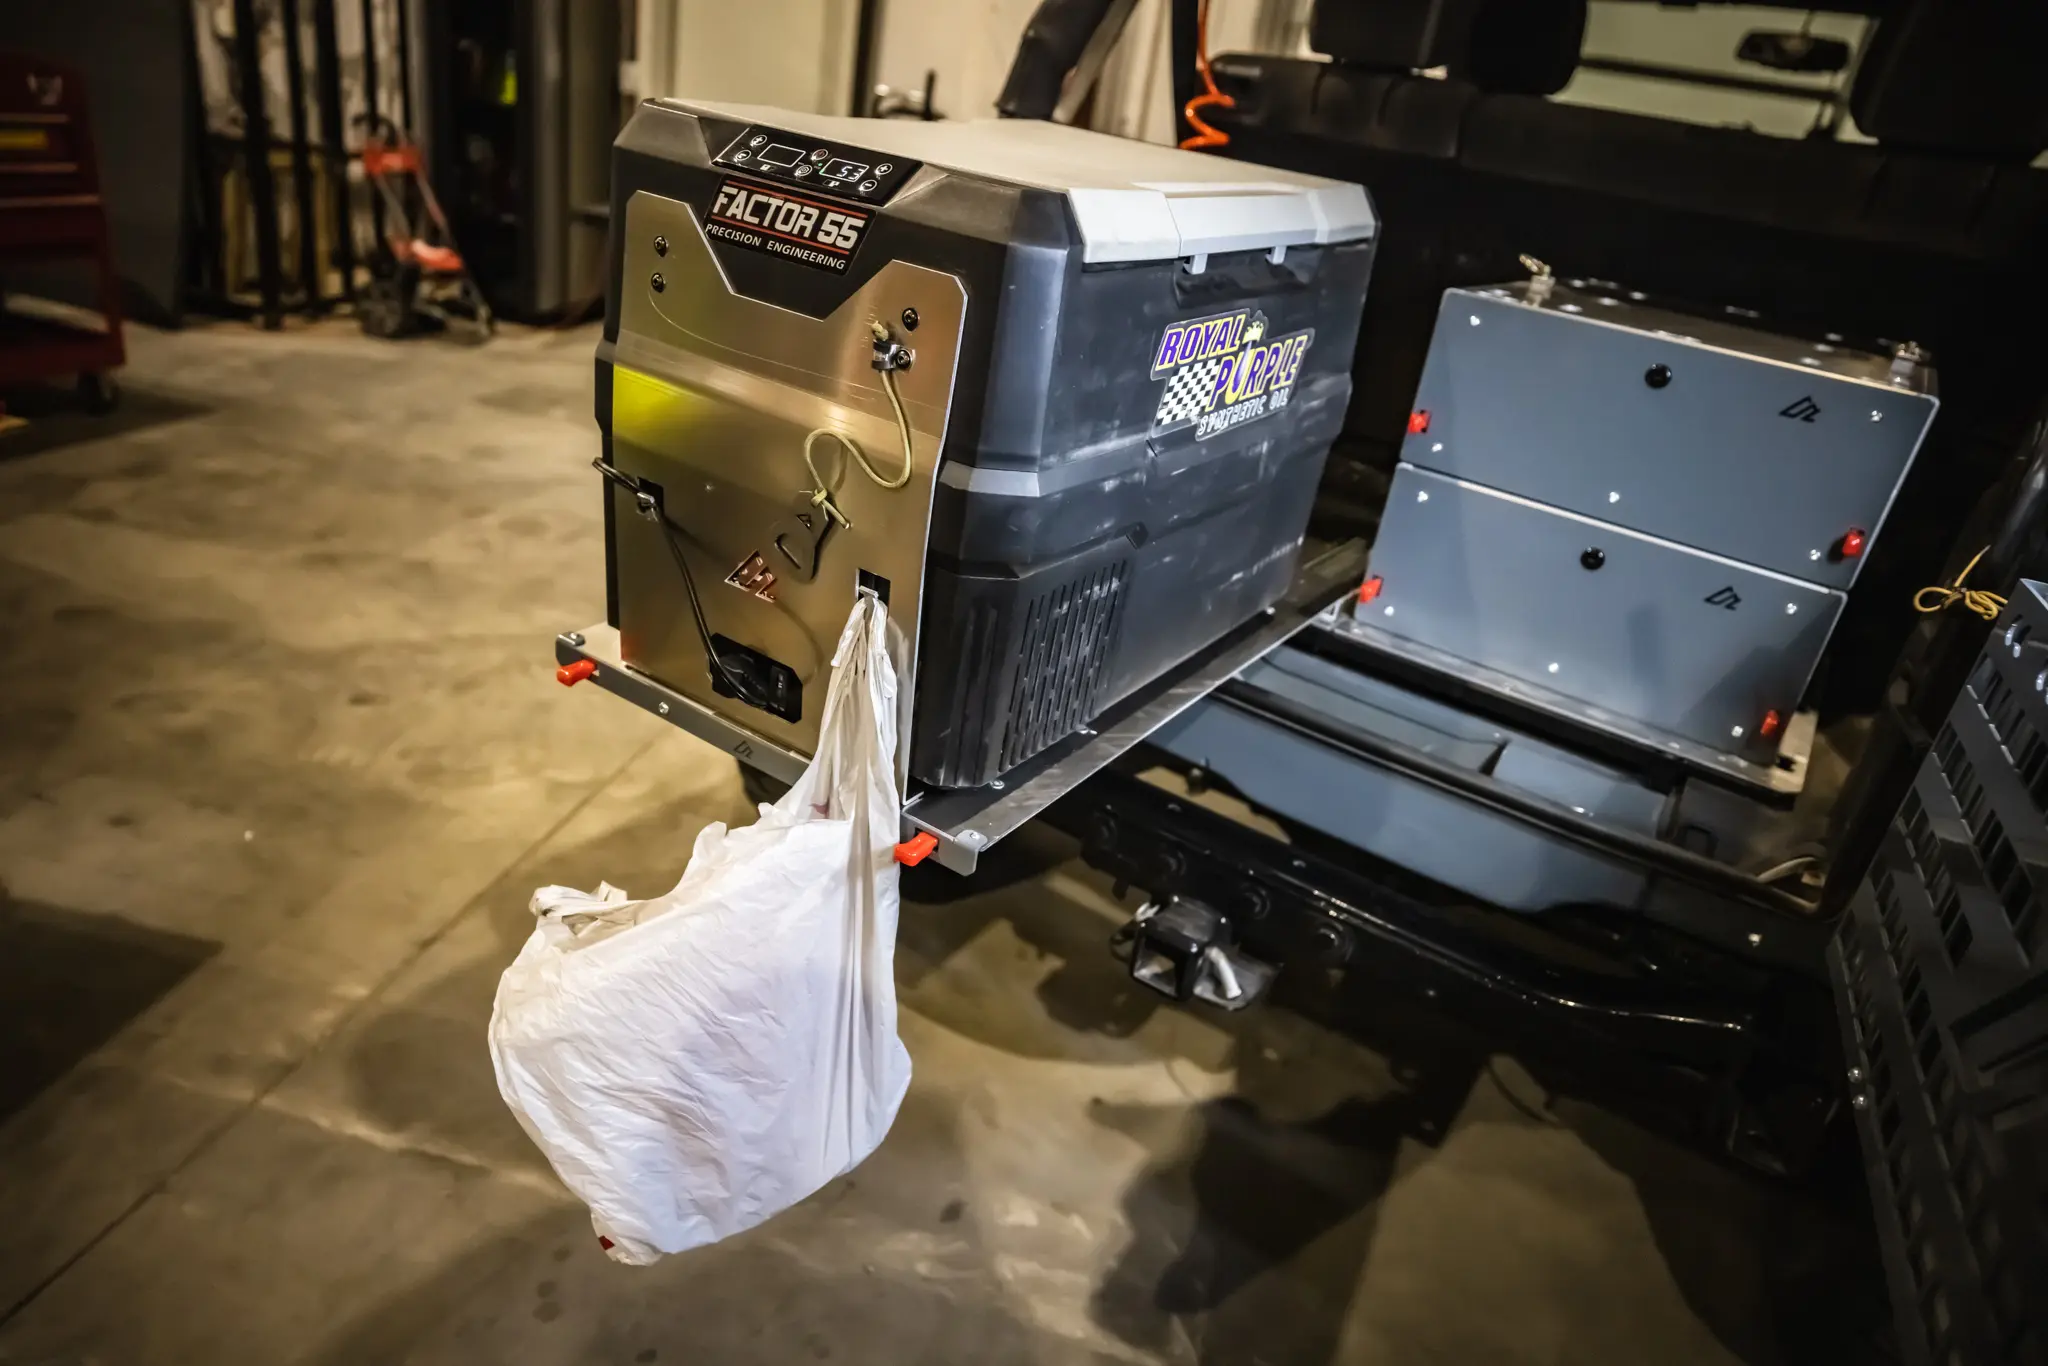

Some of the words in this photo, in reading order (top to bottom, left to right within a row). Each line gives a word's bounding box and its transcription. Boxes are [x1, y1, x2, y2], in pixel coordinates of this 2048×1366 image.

[711, 185, 820, 238] FACTOR
[816, 211, 866, 249] 55
[705, 223, 762, 247] PRECISION
[766, 240, 846, 270] ENGINEERING
[1155, 314, 1246, 371] ROYAL
[1205, 335, 1308, 412] PURPLE
[1197, 395, 1267, 436] SYNTHETIC
